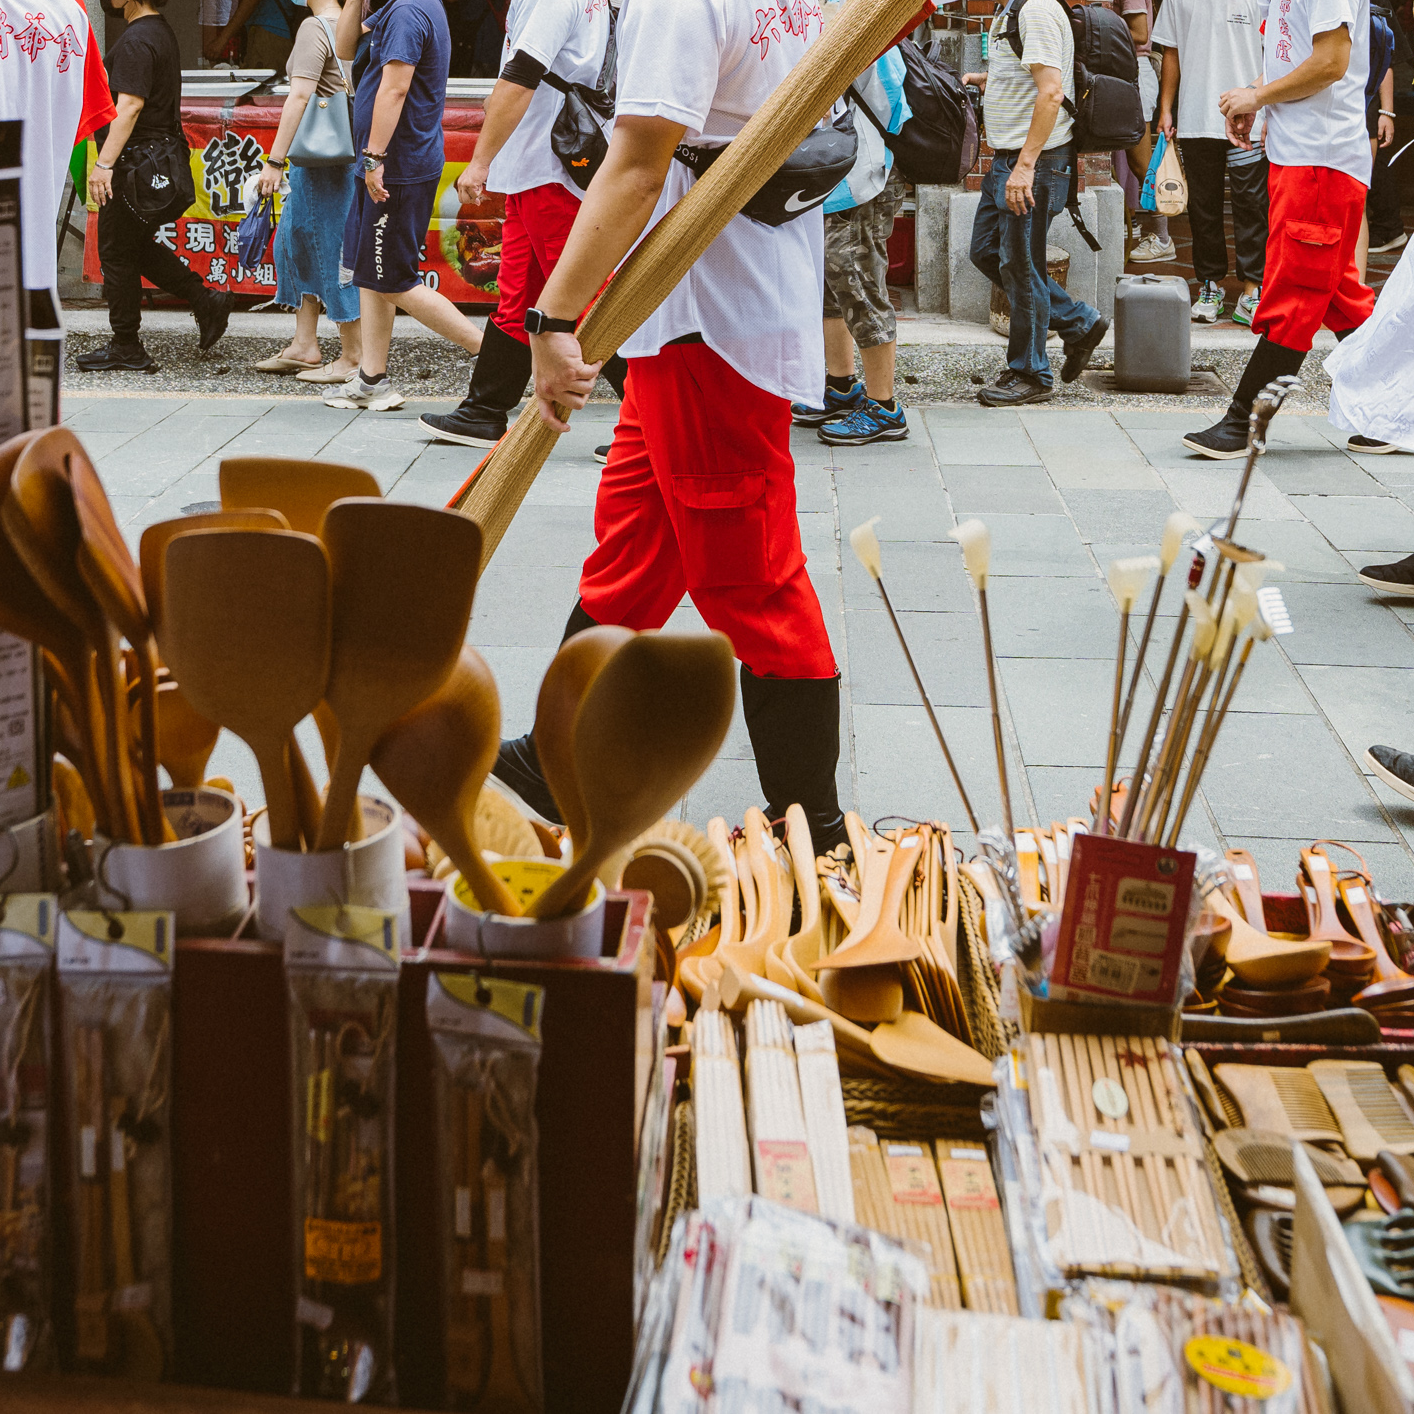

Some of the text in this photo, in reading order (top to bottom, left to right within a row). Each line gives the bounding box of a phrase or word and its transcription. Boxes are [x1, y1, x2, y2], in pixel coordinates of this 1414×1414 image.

[206, 257, 277, 285] 萬小姐
[374, 228, 384, 281] KANGOL
